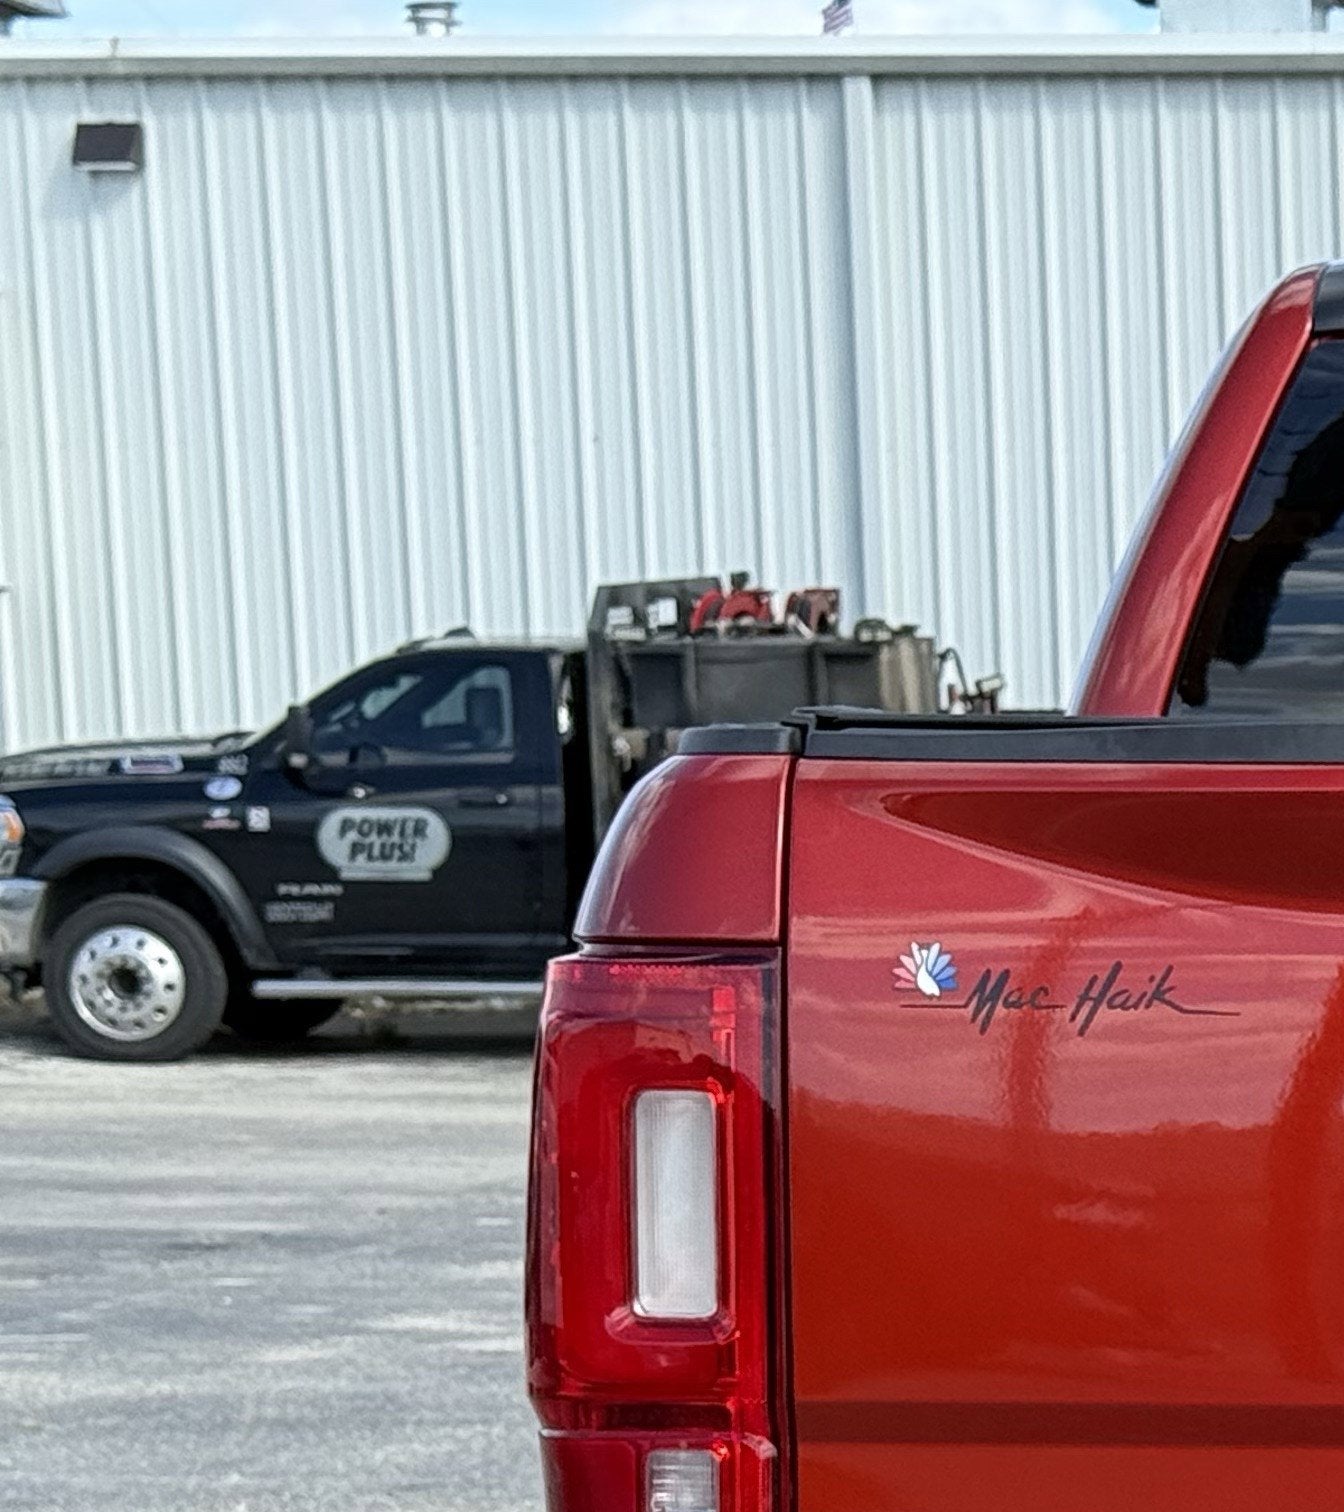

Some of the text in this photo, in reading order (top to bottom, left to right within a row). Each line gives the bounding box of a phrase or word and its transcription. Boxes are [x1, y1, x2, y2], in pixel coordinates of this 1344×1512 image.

[338, 816, 430, 841] POWER
[962, 960, 1200, 1037] Mac Haik
